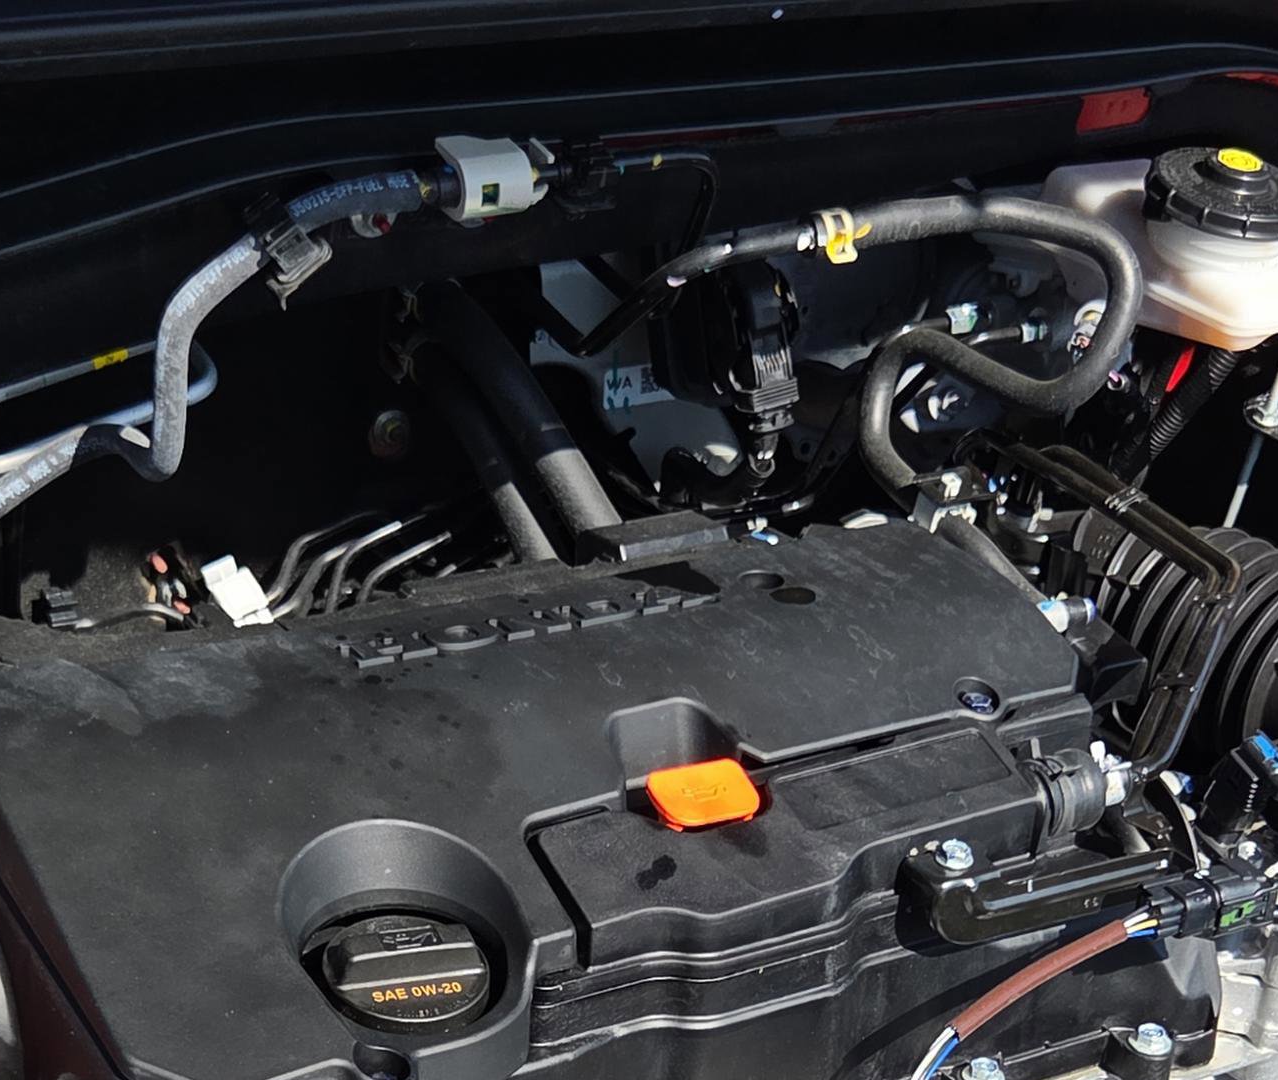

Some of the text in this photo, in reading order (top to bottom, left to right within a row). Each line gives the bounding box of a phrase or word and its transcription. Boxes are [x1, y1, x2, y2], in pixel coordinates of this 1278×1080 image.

[343, 590, 721, 668] HONDA
[372, 981, 463, 1003] SAE 0W-20
